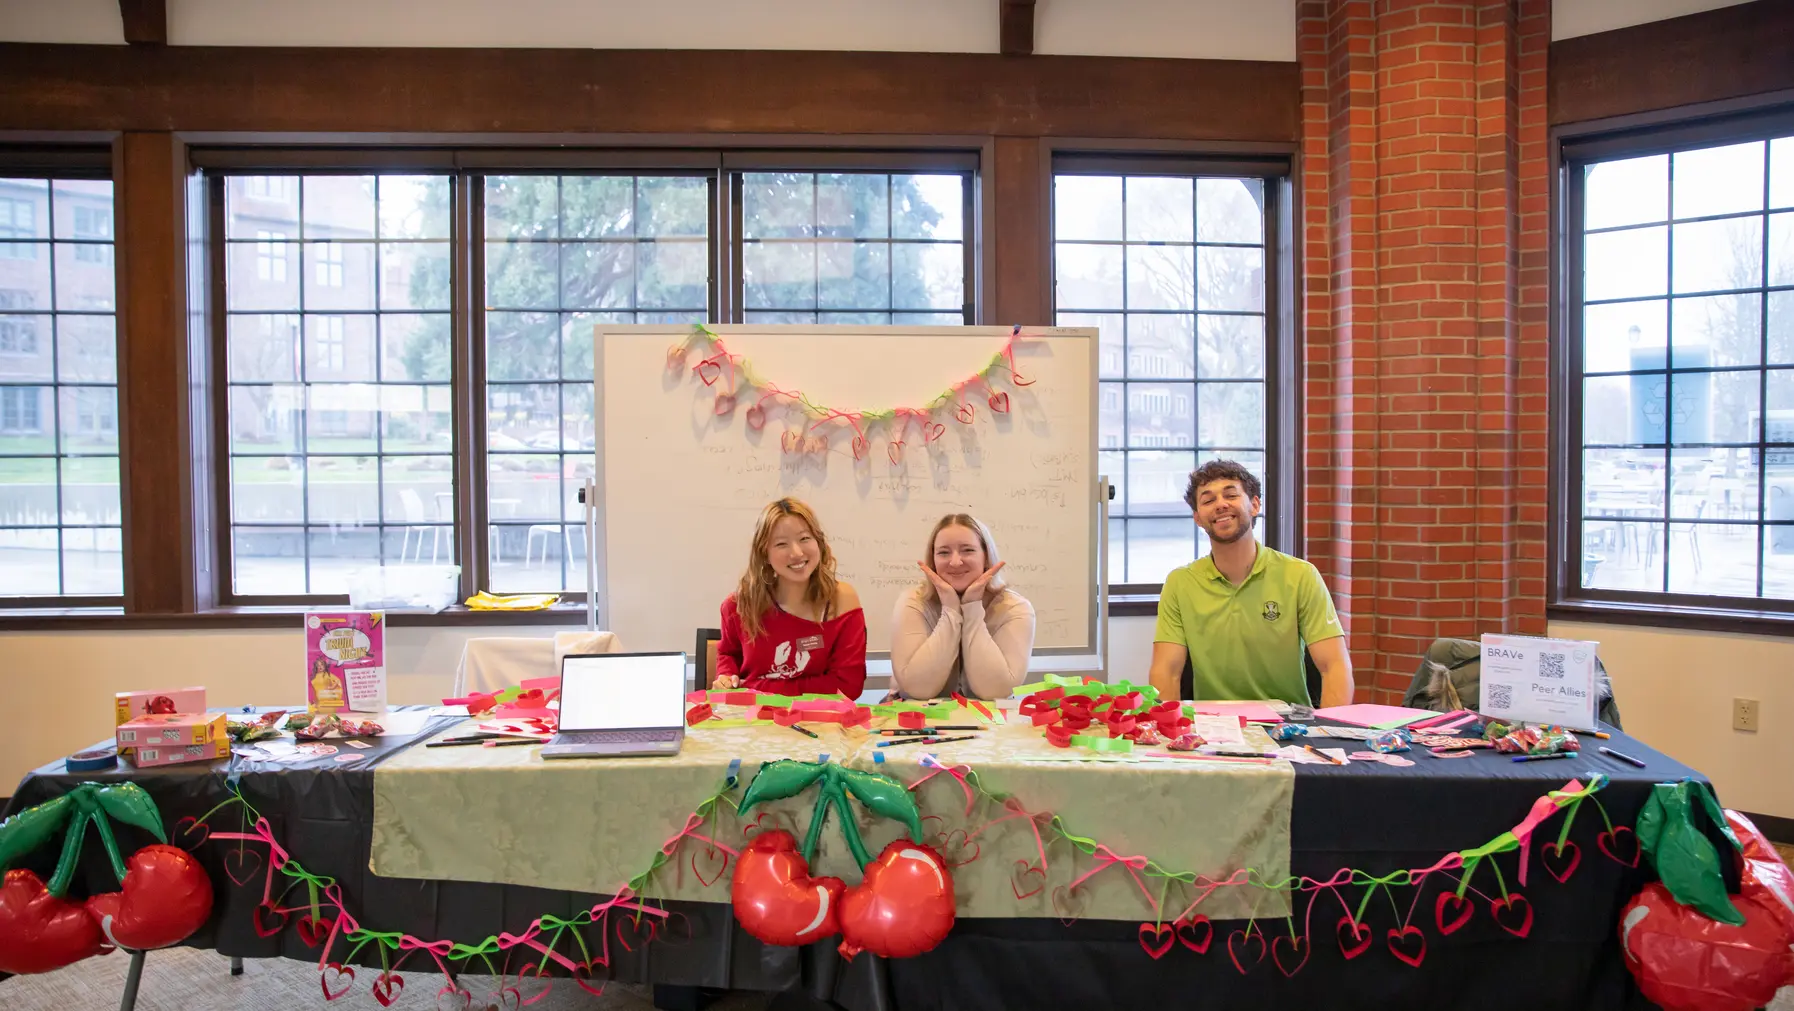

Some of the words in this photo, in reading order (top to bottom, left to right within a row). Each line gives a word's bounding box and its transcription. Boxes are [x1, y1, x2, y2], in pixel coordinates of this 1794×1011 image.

[339, 647, 367, 660] NIGHT
[1487, 647, 1524, 660] BRAVe
[1531, 682, 1555, 694] Peer
[1558, 686, 1586, 698] Allies
